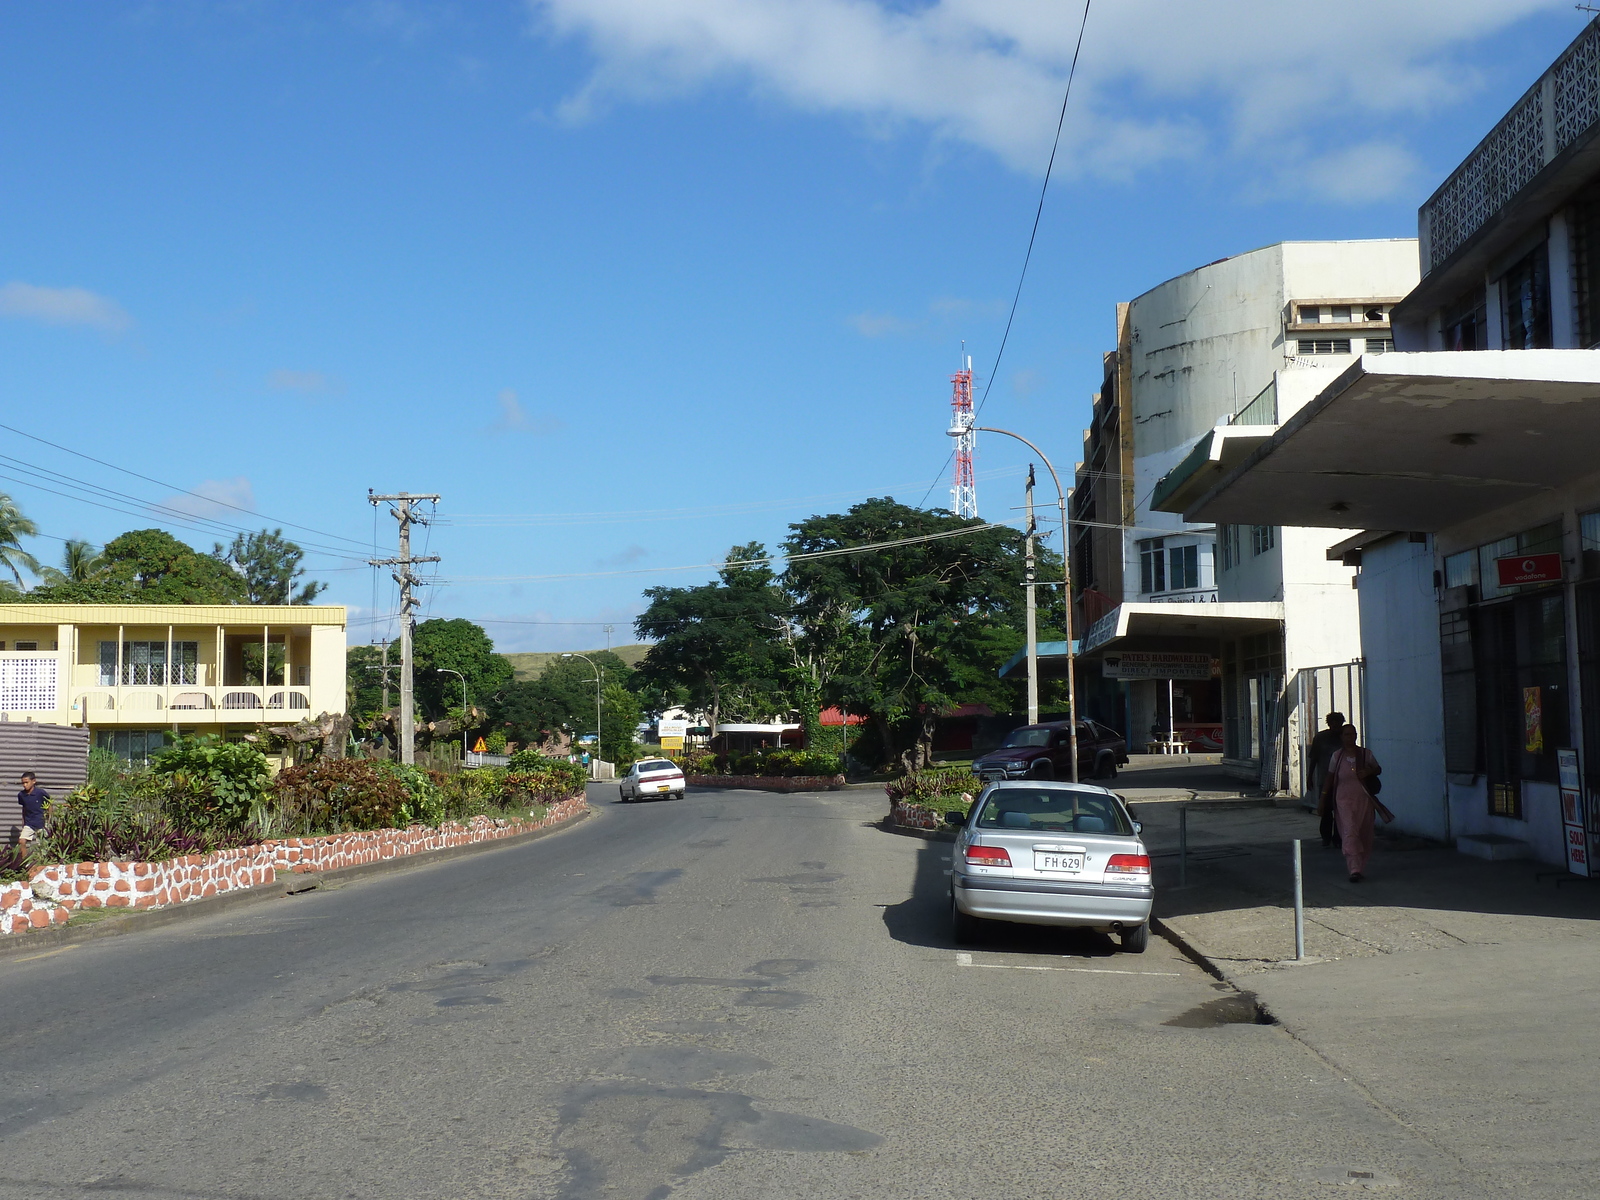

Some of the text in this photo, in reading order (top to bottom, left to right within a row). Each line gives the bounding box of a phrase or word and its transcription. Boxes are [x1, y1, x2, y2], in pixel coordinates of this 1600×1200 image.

[1514, 573, 1547, 581] vodafone
[1122, 653, 1151, 662] PATEL'S
[1152, 654, 1193, 663] HARDWARE
[1194, 655, 1209, 663] LTD
[1570, 830, 1584, 846] SOLD
[1571, 848, 1585, 864] HERE
[1044, 857, 1080, 869] FH 629
